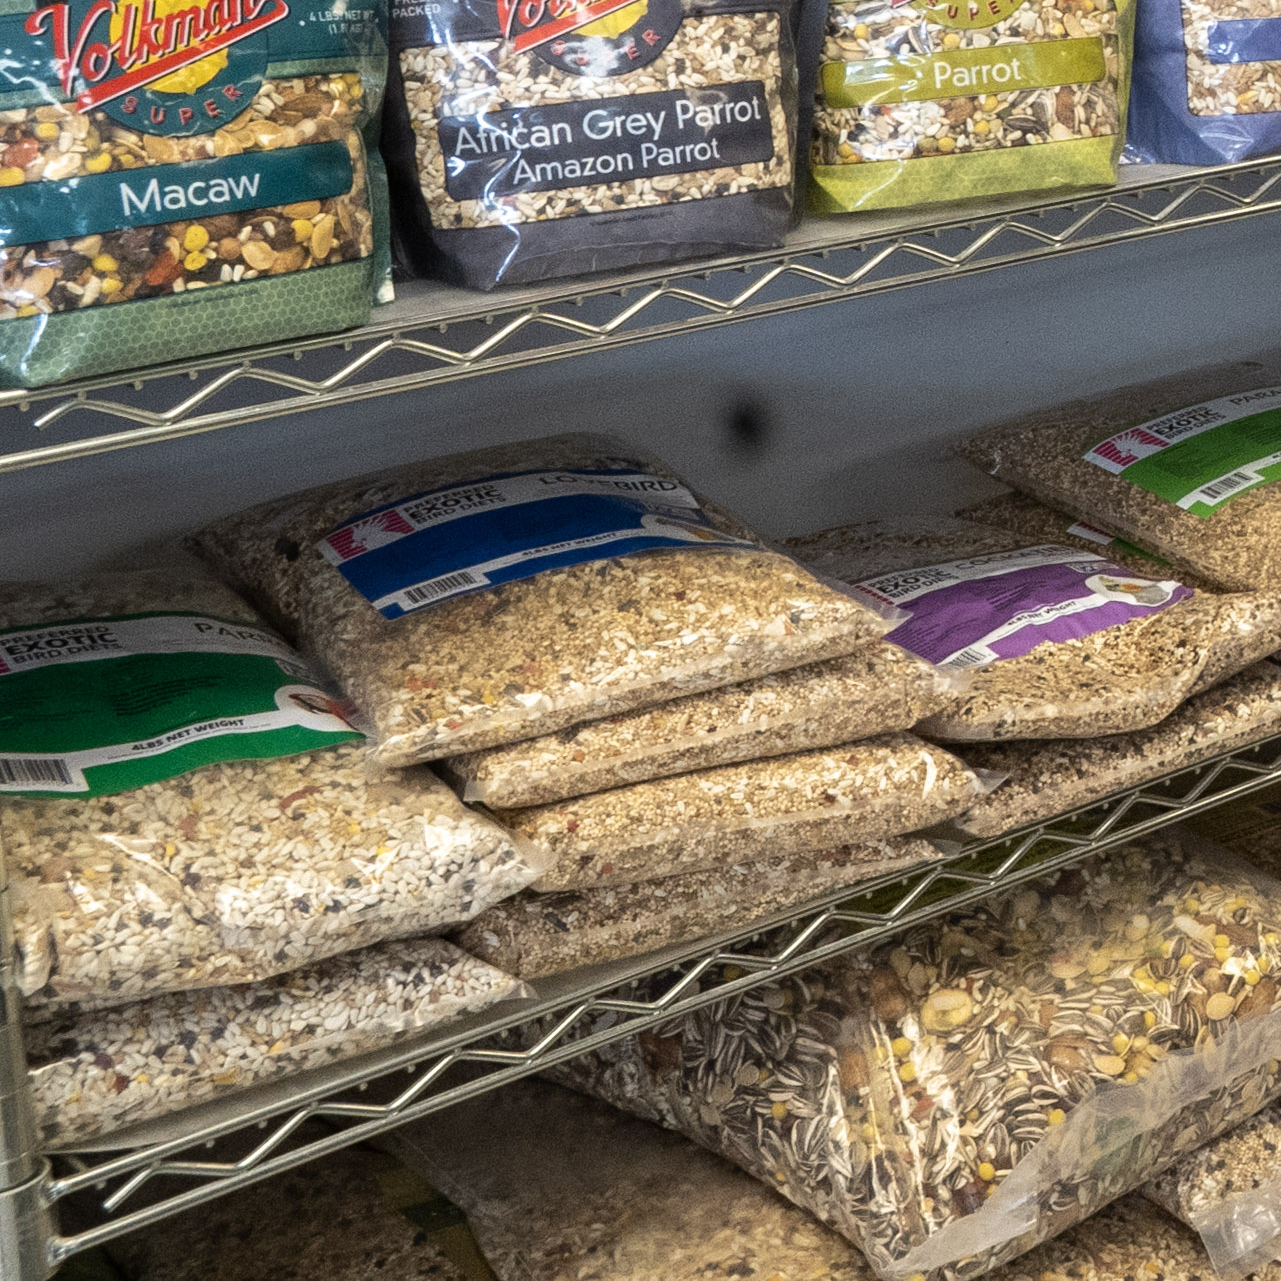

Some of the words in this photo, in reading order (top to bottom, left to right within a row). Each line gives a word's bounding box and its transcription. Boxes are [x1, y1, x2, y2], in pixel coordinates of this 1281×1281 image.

[392, 5, 441, 19] PACKED
[933, 56, 1021, 89] Parrot
[122, 82, 244, 126] SUPER
[454, 118, 573, 157] African
[582, 107, 665, 143] Grey
[676, 96, 763, 129] Parrot
[512, 151, 633, 186] Amazon
[640, 138, 721, 167] Parrot
[118, 171, 262, 217] Macaw
[1155, 410, 1222, 437] EXOTIC
[1165, 425, 1193, 441] BIRD
[403, 484, 495, 514] PREFERRED
[407, 488, 502, 520] EXOTIC
[415, 507, 457, 525] BIRD
[460, 496, 506, 514] DIETS
[521, 545, 550, 557] 4LBS
[550, 541, 572, 551] NET
[573, 531, 617, 546] WEIGHT
[877, 569, 956, 595] EXOTIC
[888, 583, 922, 600] BIRD
[0, 625, 110, 647] PREFERRED
[4, 632, 118, 656] EXOTIC
[12, 649, 56, 665] BIRD
[57, 642, 123, 658] DIETS
[131, 740, 164, 753] 4LBS
[165, 730, 192, 744] NET
[192, 718, 245, 734] WEIGHT
